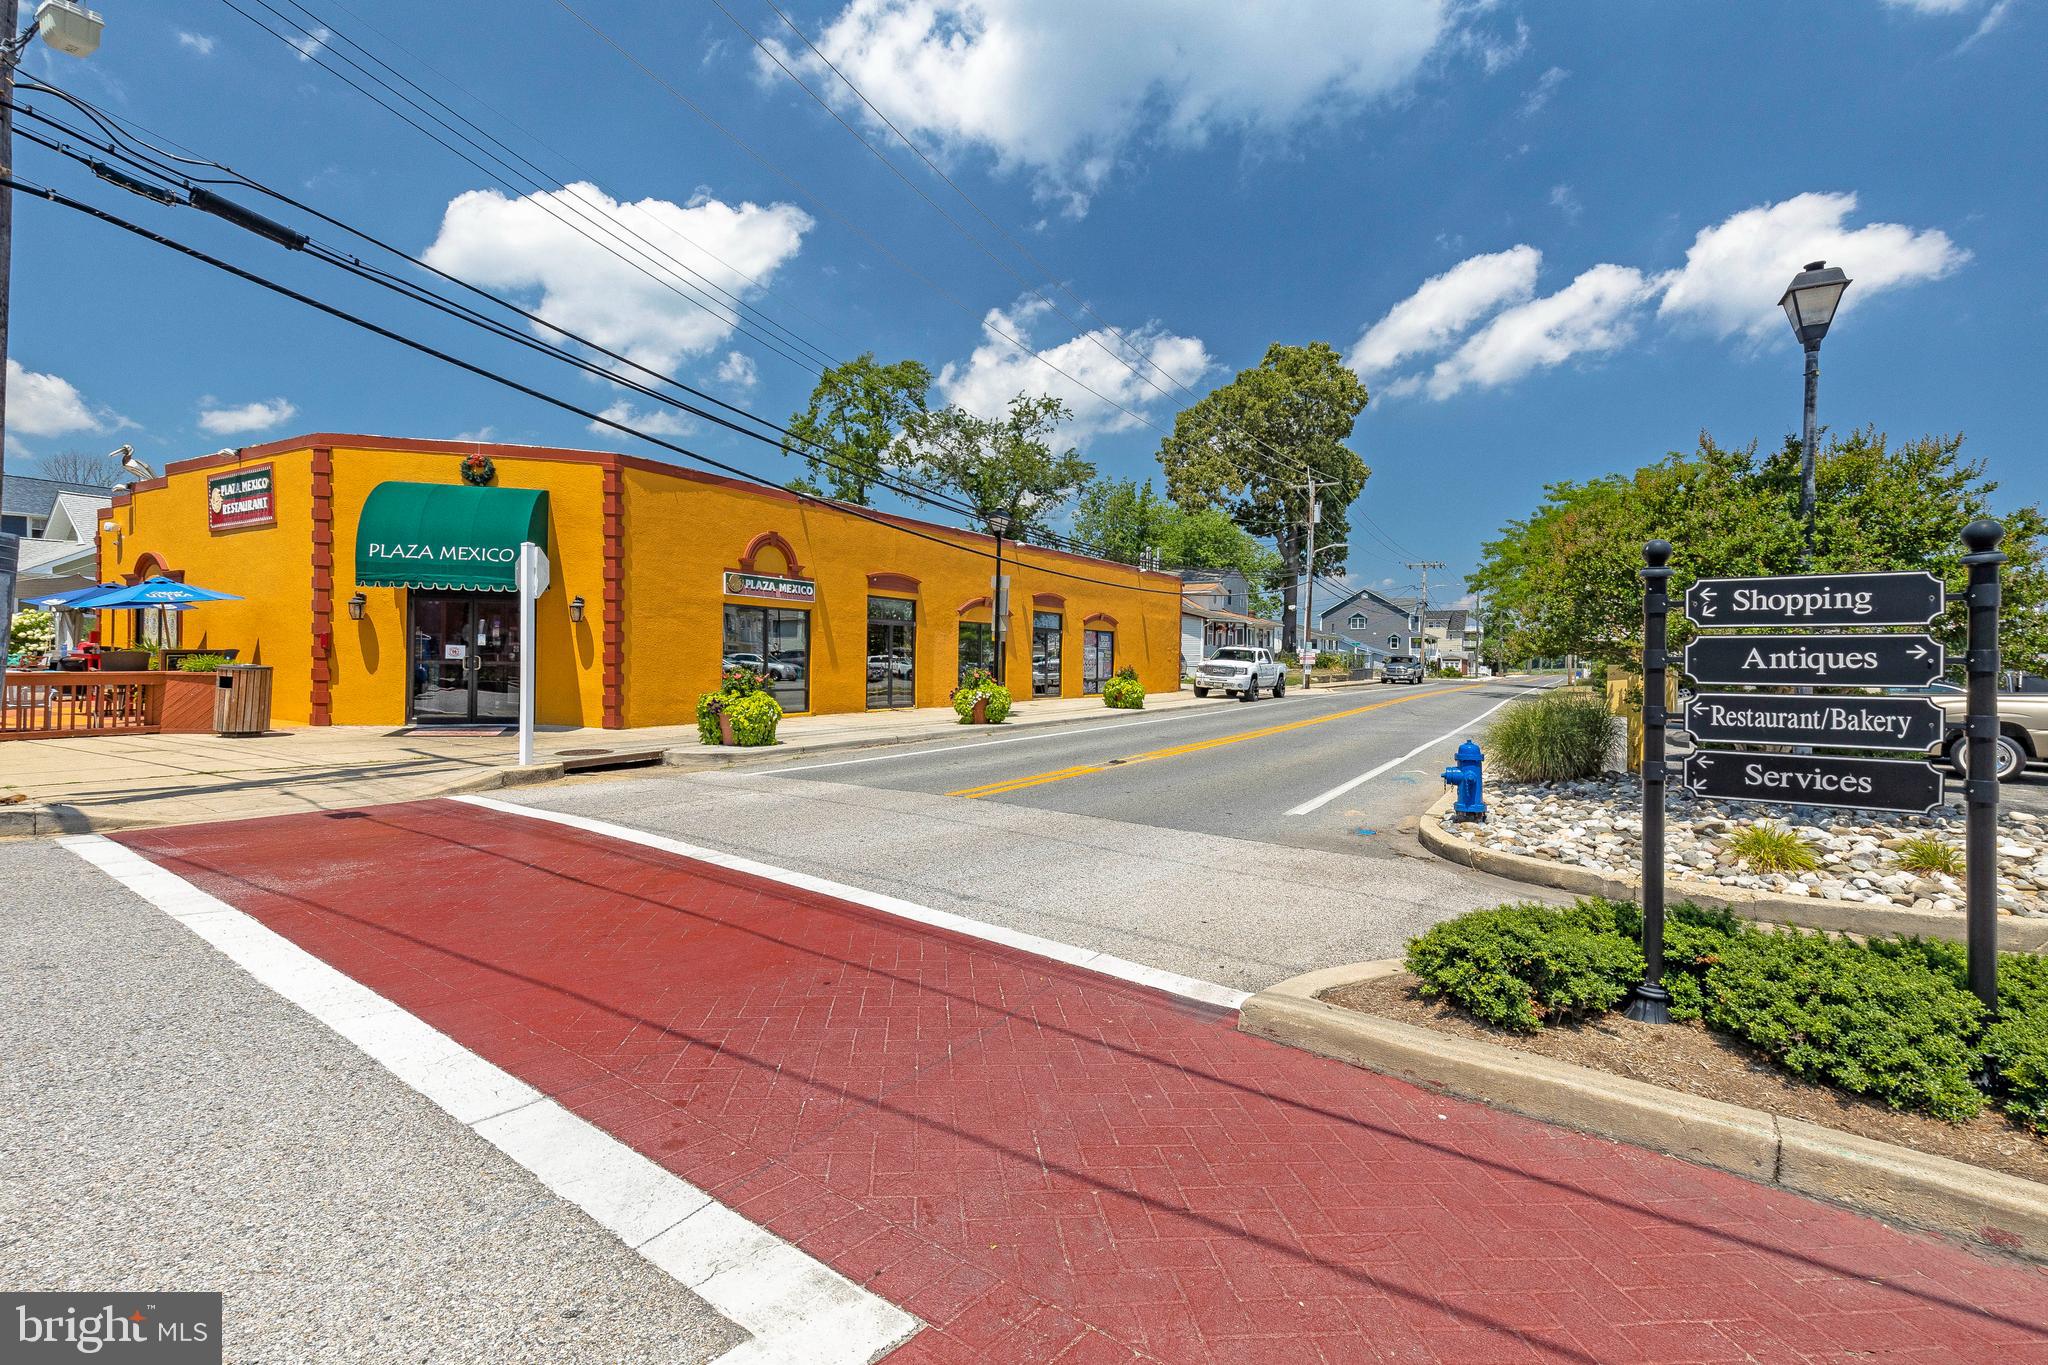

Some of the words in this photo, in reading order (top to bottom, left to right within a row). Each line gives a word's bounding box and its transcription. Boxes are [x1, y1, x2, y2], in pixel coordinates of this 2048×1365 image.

[221, 482, 242, 496] PLAZA
[241, 477, 269, 493] MEXICO
[222, 497, 268, 515] RESTAURANT
[368, 543, 434, 560] PLAZA
[439, 546, 515, 562] MEXICO
[745, 579, 776, 592] PLAZA
[778, 583, 814, 596] MEXICO
[1732, 586, 1873, 616] Shopping
[1741, 646, 1878, 675] Antiques
[1710, 704, 1912, 739] Restaurant/Bakery
[1745, 763, 1873, 793] Services
